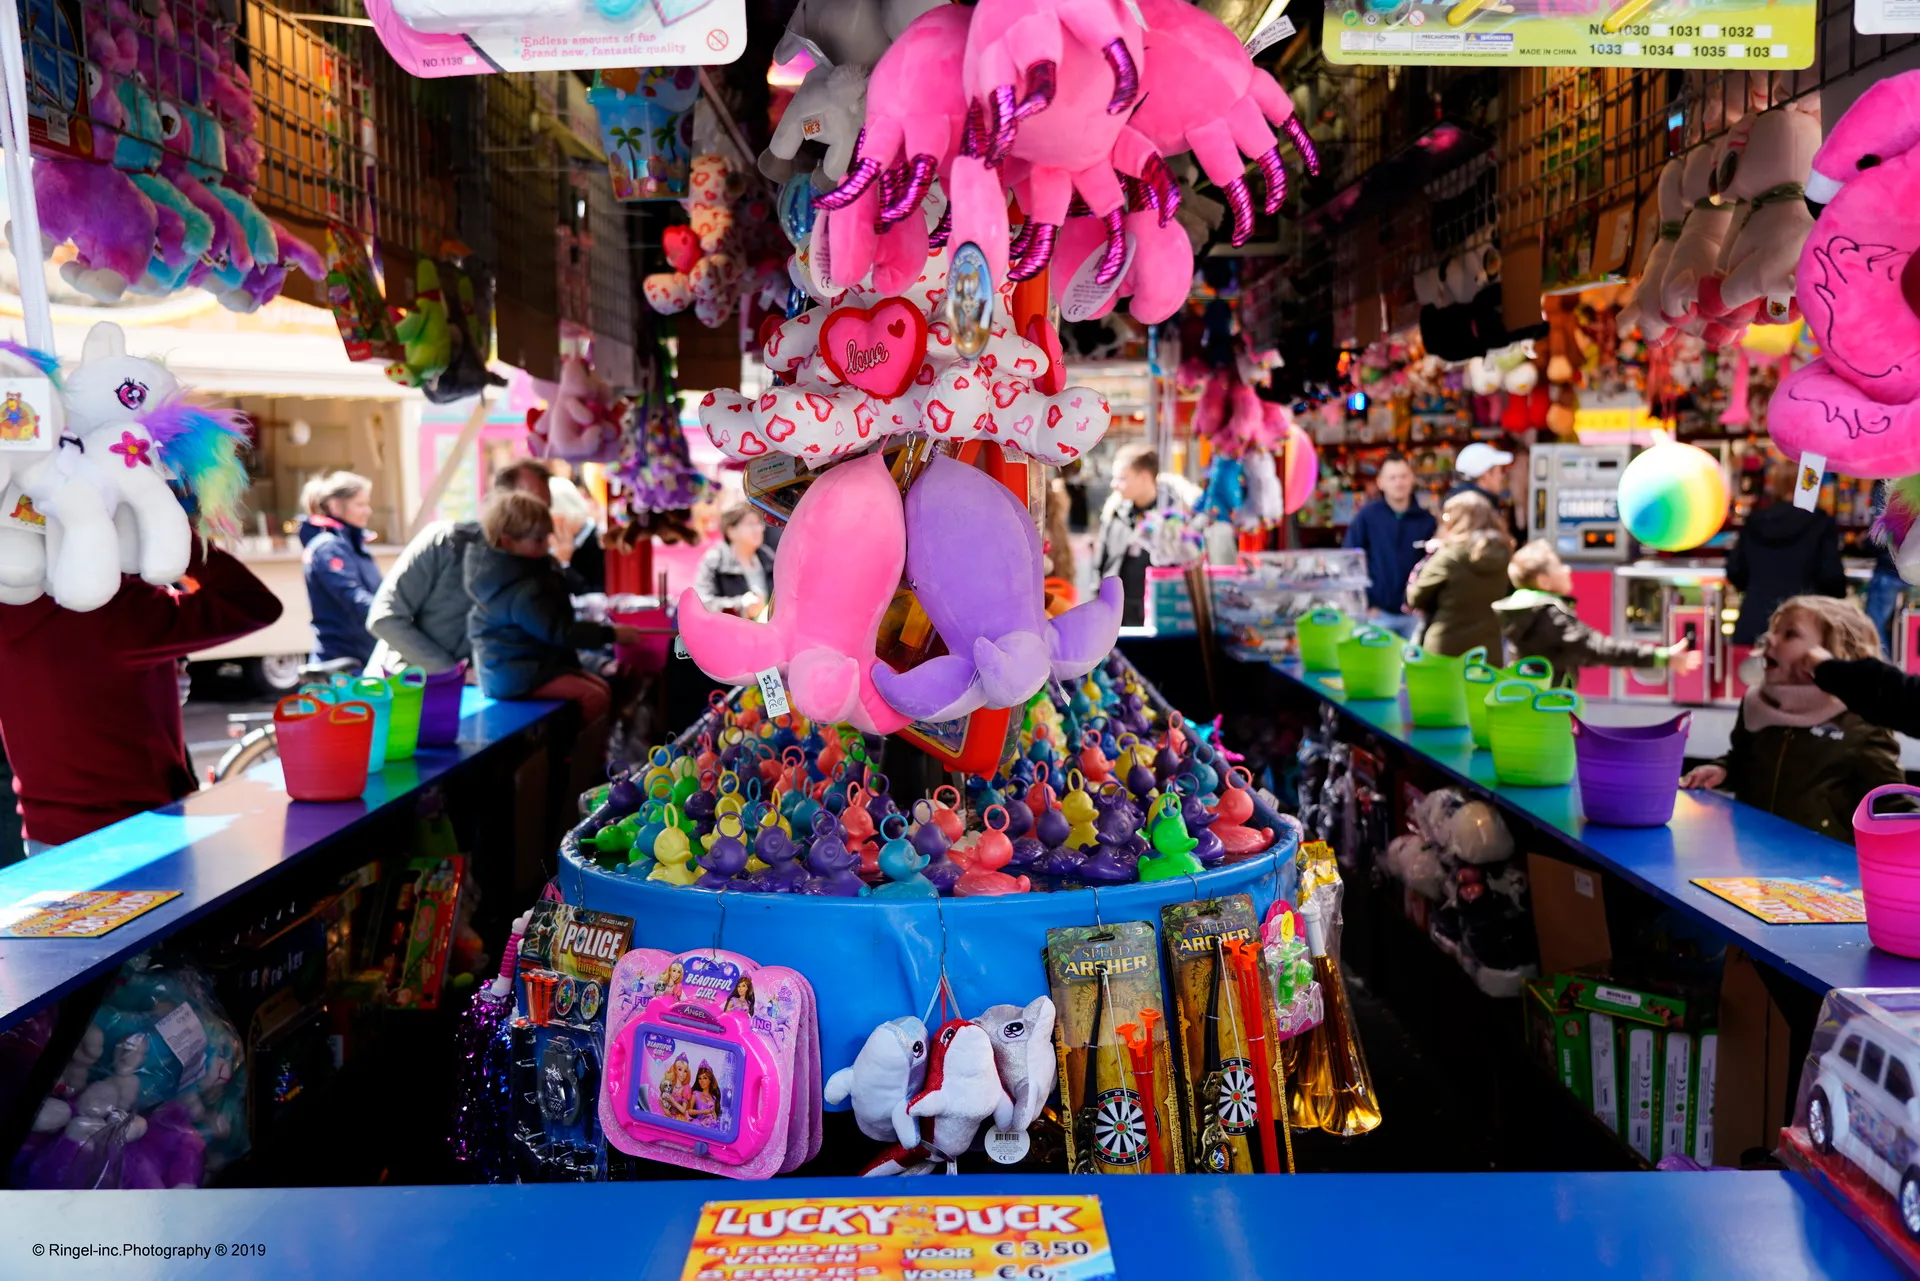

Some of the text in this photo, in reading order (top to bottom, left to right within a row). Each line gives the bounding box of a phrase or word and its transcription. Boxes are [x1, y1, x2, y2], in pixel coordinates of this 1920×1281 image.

[1589, 24, 1754, 37] NO1030 1031 1032
[520, 33, 656, 46] Endless amounts of fun
[521, 48, 557, 60] Brand
[592, 45, 641, 56] fantastic
[646, 43, 686, 55] quality
[1519, 48, 1542, 56] MADE
[1589, 44, 1769, 57] 1033 1034 1035 103
[422, 56, 463, 68] NO.1130
[845, 339, 890, 375] love
[1192, 920, 1234, 935] SPEED
[561, 923, 623, 961] POLICE
[1082, 944, 1131, 959] SPEED
[577, 961, 592, 974] ELITE
[696, 986, 718, 1000] GIRL
[683, 1006, 706, 1019] ANGEL
[713, 1204, 1083, 1238] LUCKY DUCK
[737, 1243, 882, 1256] EENDJES
[904, 1241, 1090, 1260] VOOR € 3,50
[724, 1252, 859, 1266] VANGEN
[732, 1266, 881, 1279] EENDJES
[904, 1268, 976, 1281] VOOR
[997, 1264, 1017, 1281] €
